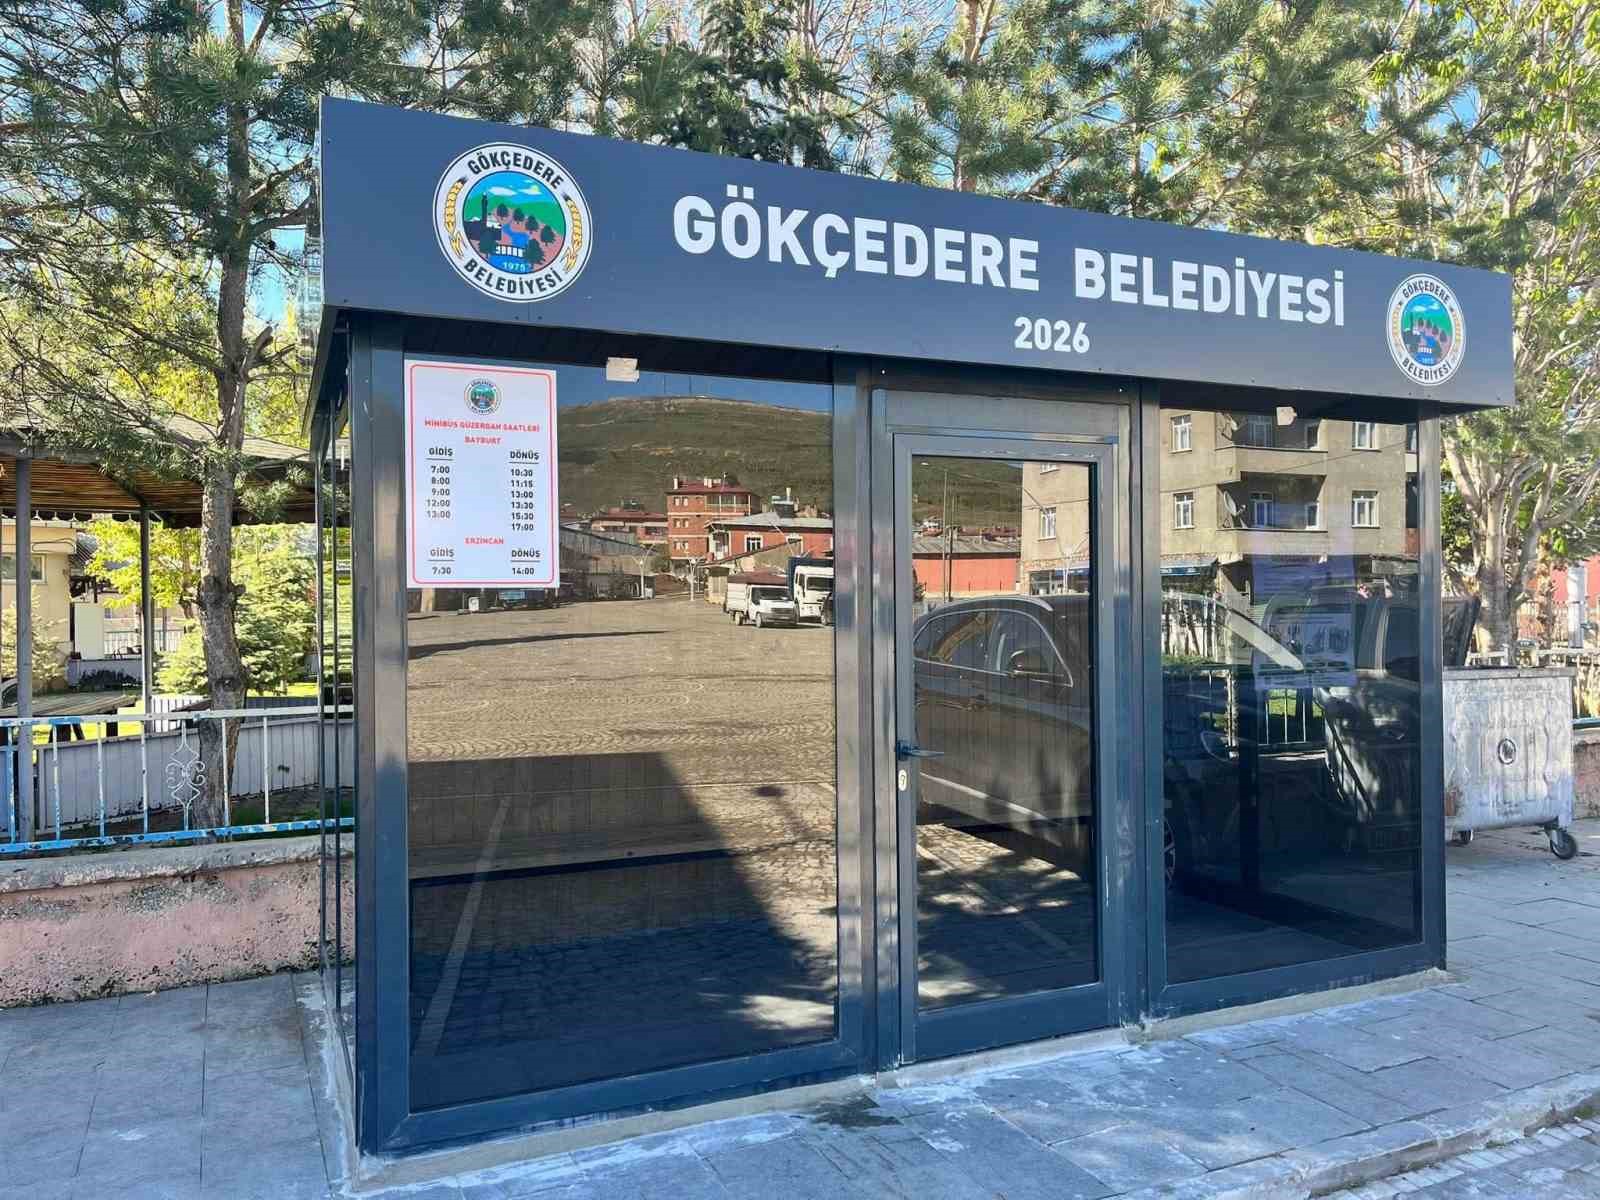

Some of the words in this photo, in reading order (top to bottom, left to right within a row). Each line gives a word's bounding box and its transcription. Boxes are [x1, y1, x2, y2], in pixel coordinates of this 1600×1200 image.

[467, 150, 564, 190] GÖKÇEDERE
[673, 184, 1039, 291] GÖKÇEDERE
[1074, 247, 1345, 326] BELEDİYESİ
[503, 261, 526, 271] 1975
[464, 258, 563, 295] BELEDİYESİ
[1402, 280, 1451, 304] GÖKÇEDERE
[1013, 316, 1090, 353] 2026
[1402, 358, 1452, 381] BELEDİYESİ
[464, 436, 501, 445] BAYBURT
[428, 446, 453, 457] GİDİŞ
[510, 450, 539, 460] DÖNÜŞ
[431, 465, 450, 474] 7:00
[511, 469, 533, 477] 10:30
[431, 476, 450, 485] 8:00
[511, 480, 533, 488] 11:15
[431, 488, 450, 496] 9:00
[511, 490, 533, 498] 13:00
[427, 499, 450, 507] 12:00
[511, 501, 534, 509] 13:30
[427, 510, 451, 519] 13:00
[511, 512, 534, 520] 15:30
[511, 523, 534, 531] 17:00
[432, 566, 452, 575] 7:30
[512, 567, 535, 575] 14:00
